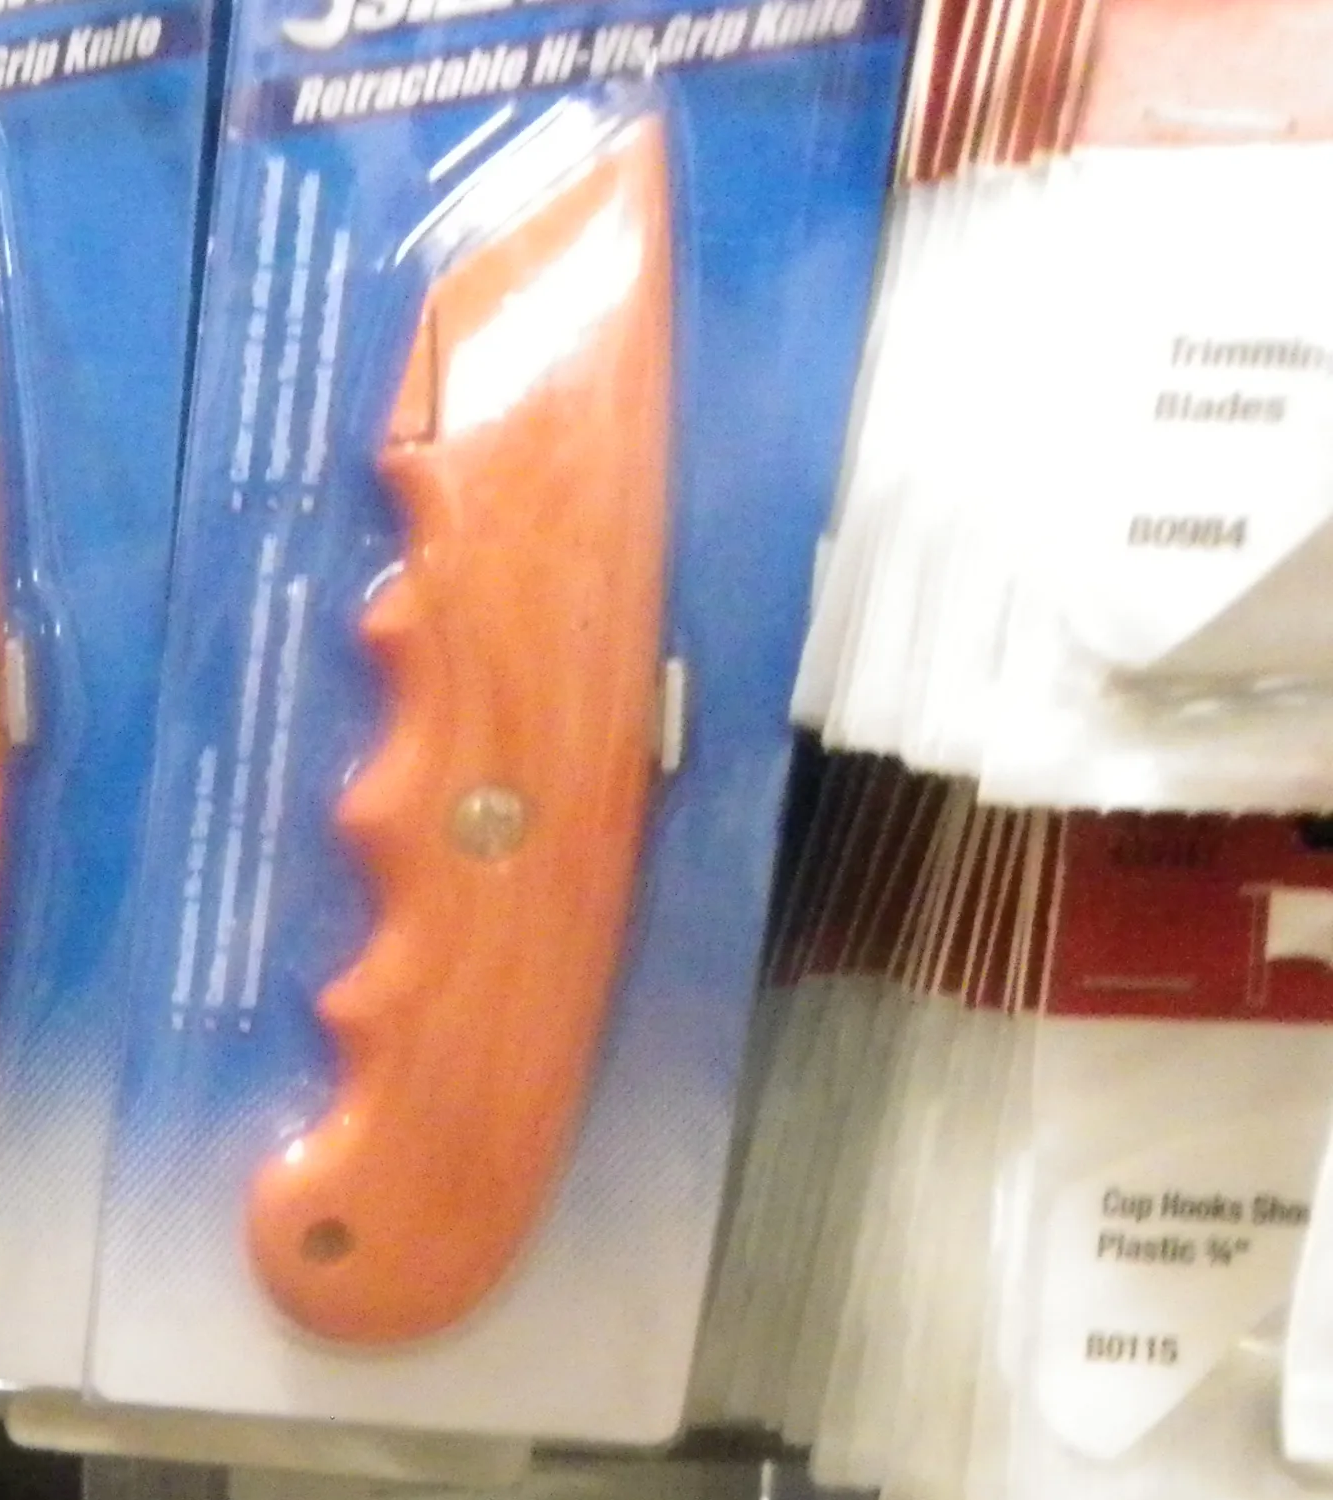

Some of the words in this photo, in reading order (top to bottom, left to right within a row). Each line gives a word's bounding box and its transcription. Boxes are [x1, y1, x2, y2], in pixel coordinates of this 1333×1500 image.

[64, 14, 163, 74] Knife
[294, 46, 529, 124] Retractable
[662, 9, 747, 63] Grip
[750, 0, 864, 49] Knife
[1102, 1187, 1153, 1224] Cup
[1161, 1187, 1244, 1222] Hooks
[1097, 1233, 1195, 1266] Plastic
